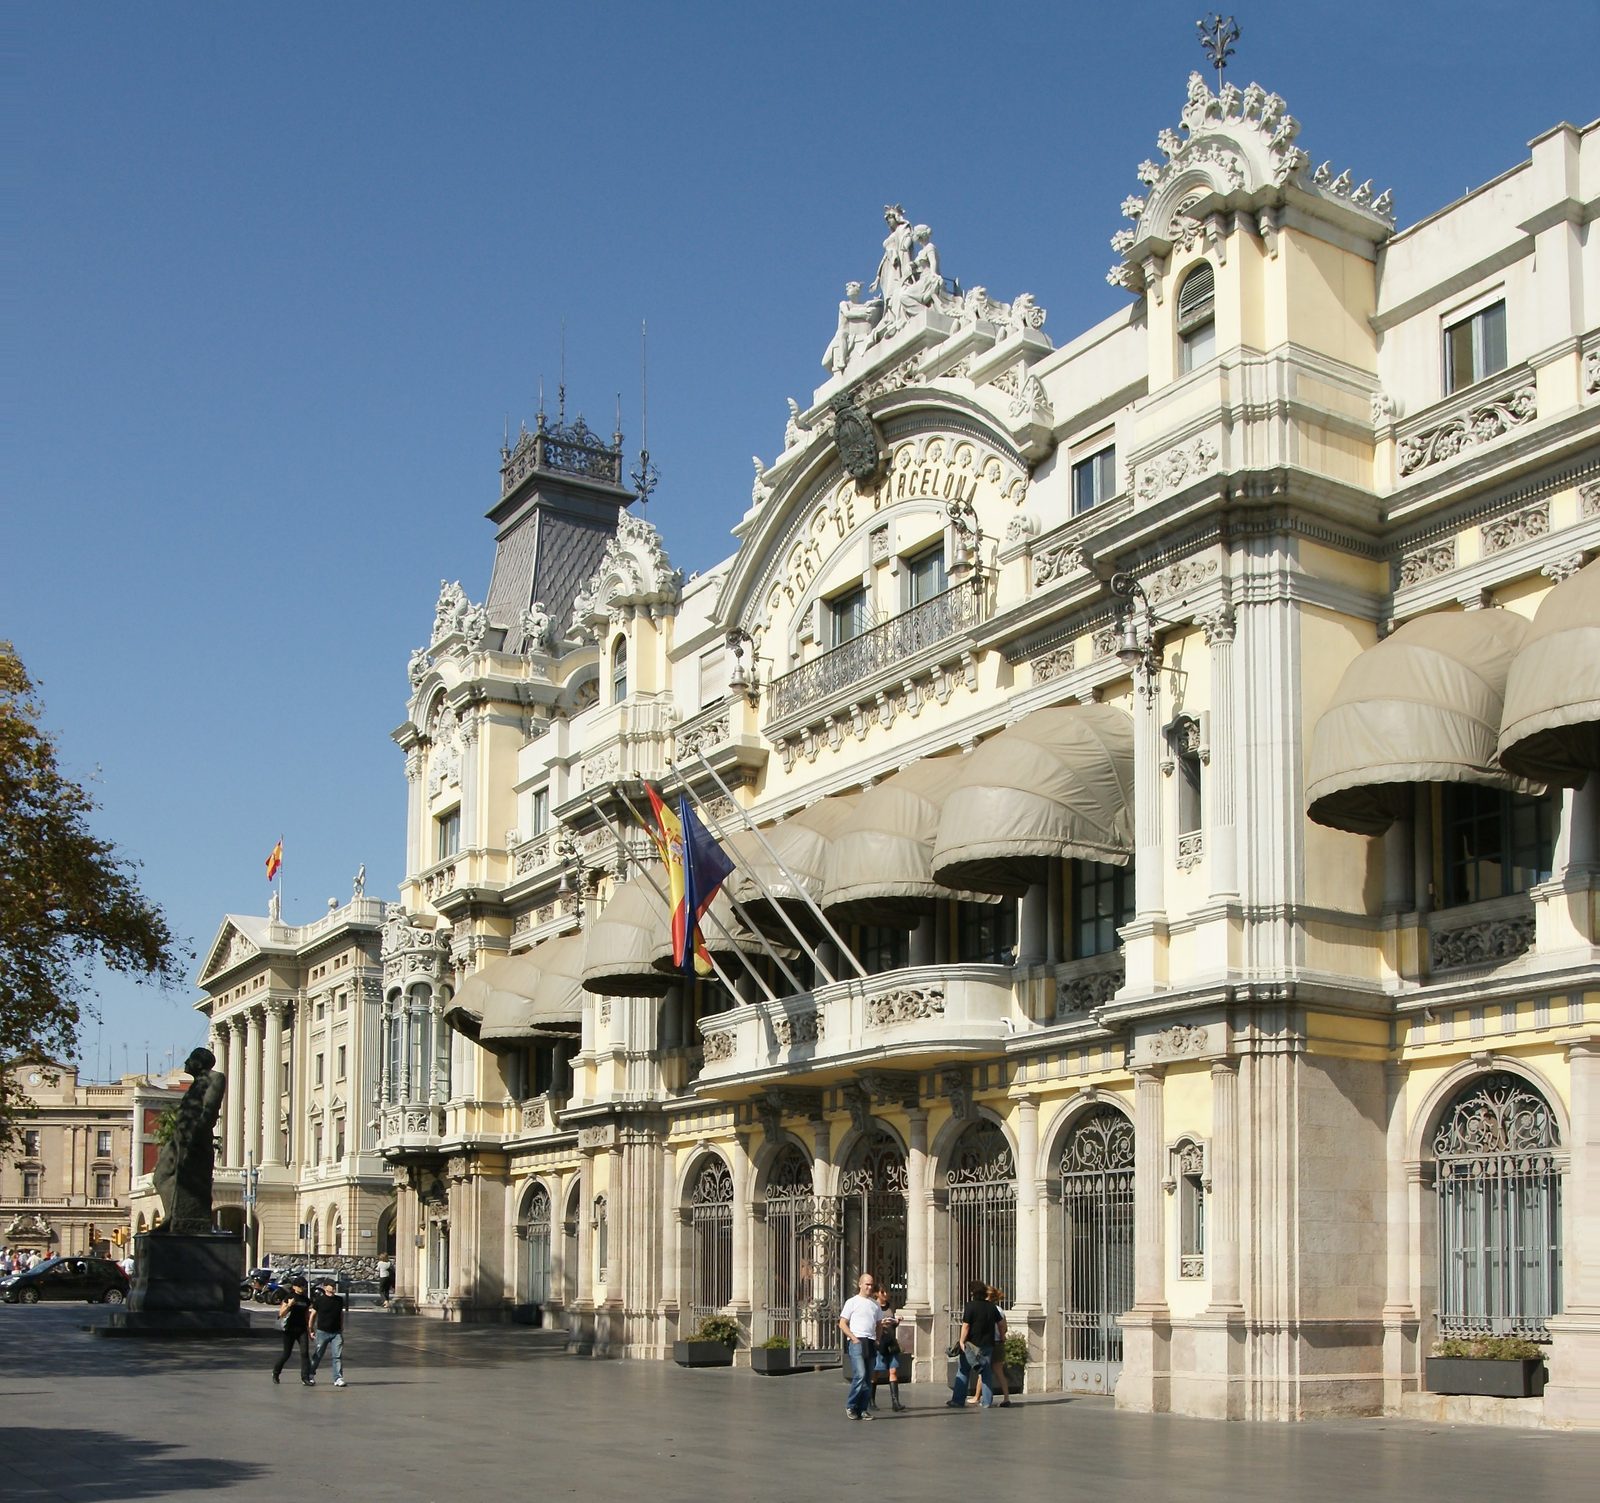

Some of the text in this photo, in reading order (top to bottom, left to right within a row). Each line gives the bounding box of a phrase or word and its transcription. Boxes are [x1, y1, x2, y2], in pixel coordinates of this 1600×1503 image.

[785, 468, 978, 607] PORT DE BARCELONA
